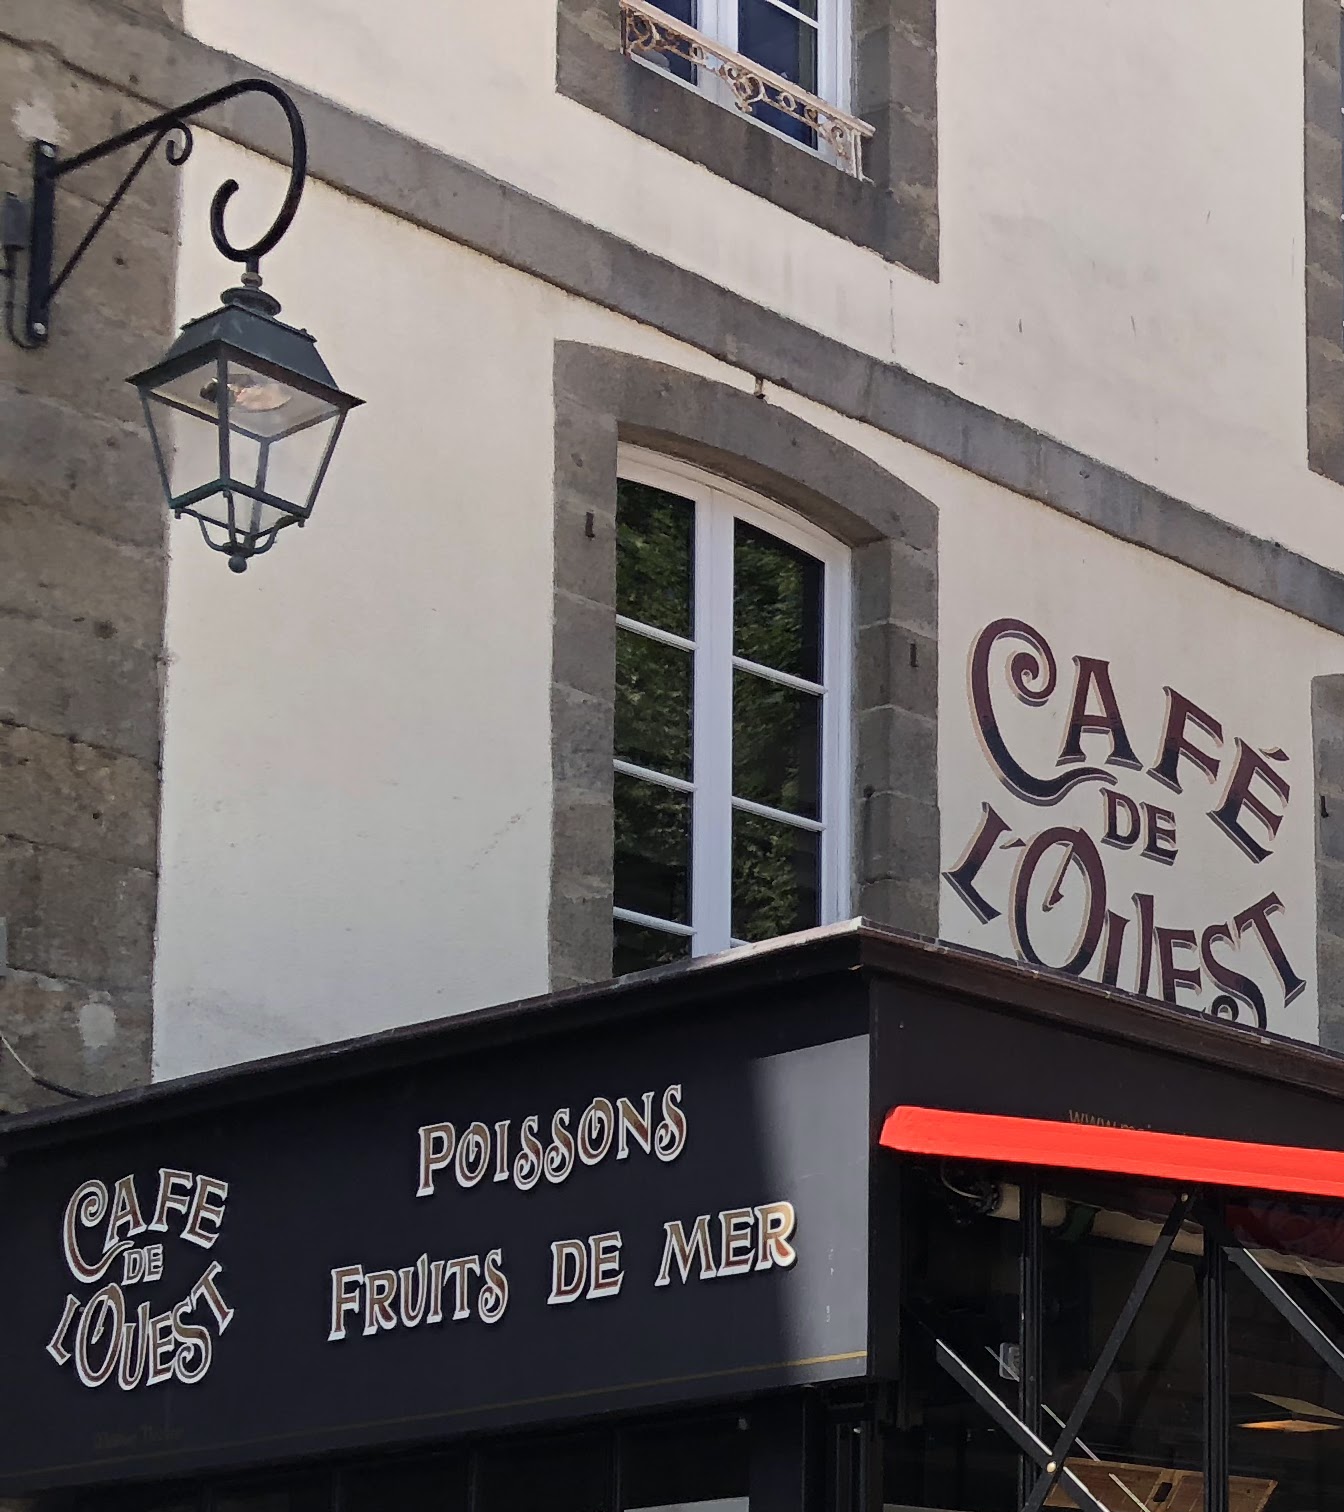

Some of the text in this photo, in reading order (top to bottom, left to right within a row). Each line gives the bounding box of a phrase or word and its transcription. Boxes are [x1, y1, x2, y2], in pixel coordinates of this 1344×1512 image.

[967, 617, 1291, 864] CAFÉ
[1099, 786, 1179, 865] DE
[416, 1083, 687, 1198] POISSONS
[63, 1167, 229, 1284] CAFE
[121, 1243, 163, 1286] DE
[327, 1200, 798, 1343] FRUITS DE MER
